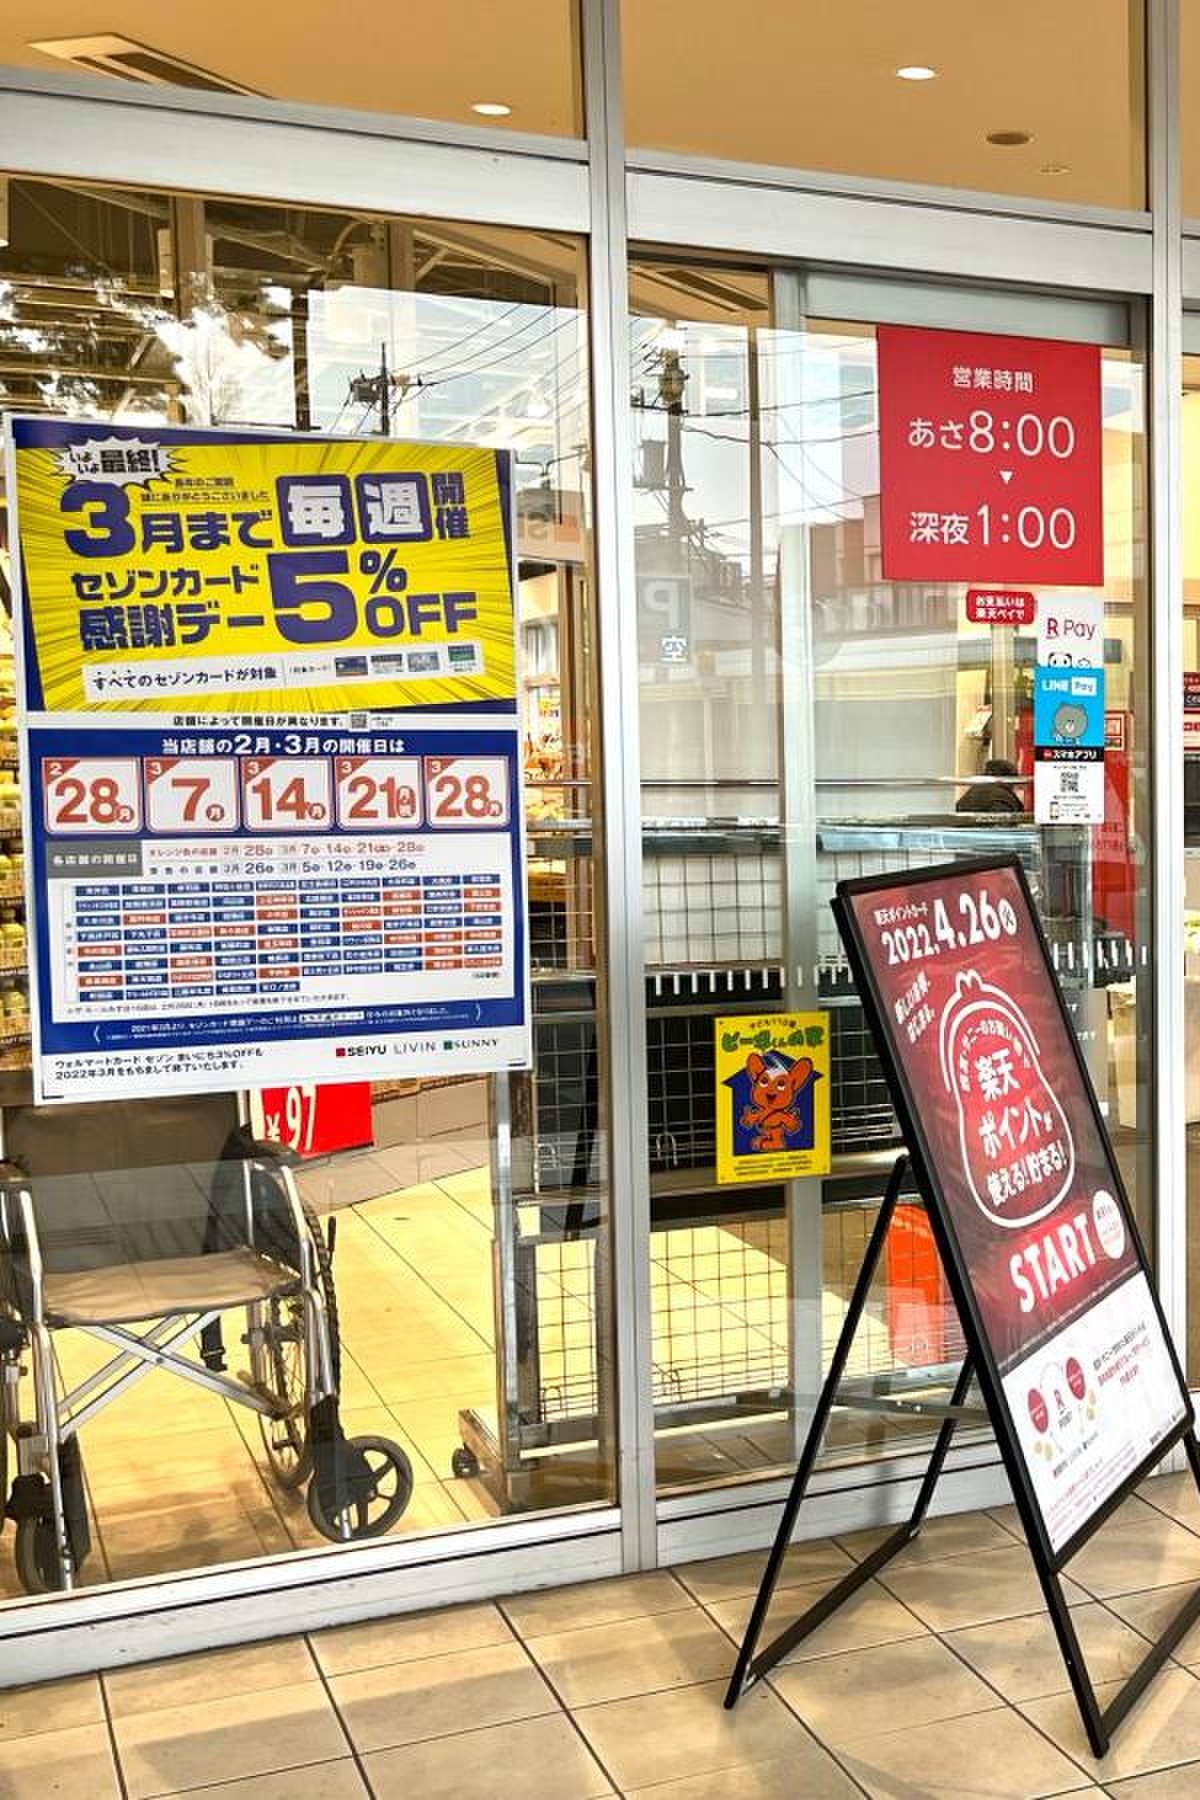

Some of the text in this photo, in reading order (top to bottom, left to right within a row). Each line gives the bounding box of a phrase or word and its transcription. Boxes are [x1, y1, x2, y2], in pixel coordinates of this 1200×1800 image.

[952, 366, 1033, 393] 営業時間
[908, 411, 1075, 458] あさ8:00
[60, 481, 273, 558] 3月まで
[909, 504, 1075, 549] 深夜1:00
[71, 564, 259, 601] セゾンカード
[79, 600, 265, 652] 感謝デー
[365, 591, 478, 638] OFF
[1063, 619, 1097, 640] Pay
[151, 763, 162, 776] 3
[341, 761, 352, 774] 3
[431, 760, 442, 773] 3
[55, 777, 119, 823] 28
[171, 778, 211, 821] 7
[252, 777, 307, 820] 14
[350, 775, 397, 819] 21
[435, 775, 491, 818] 28
[347, 1038, 498, 1058] SEIYU LIVIN SUNNY
[975, 1047, 1020, 1102] 楽天
[1008, 1212, 1096, 1313] START
